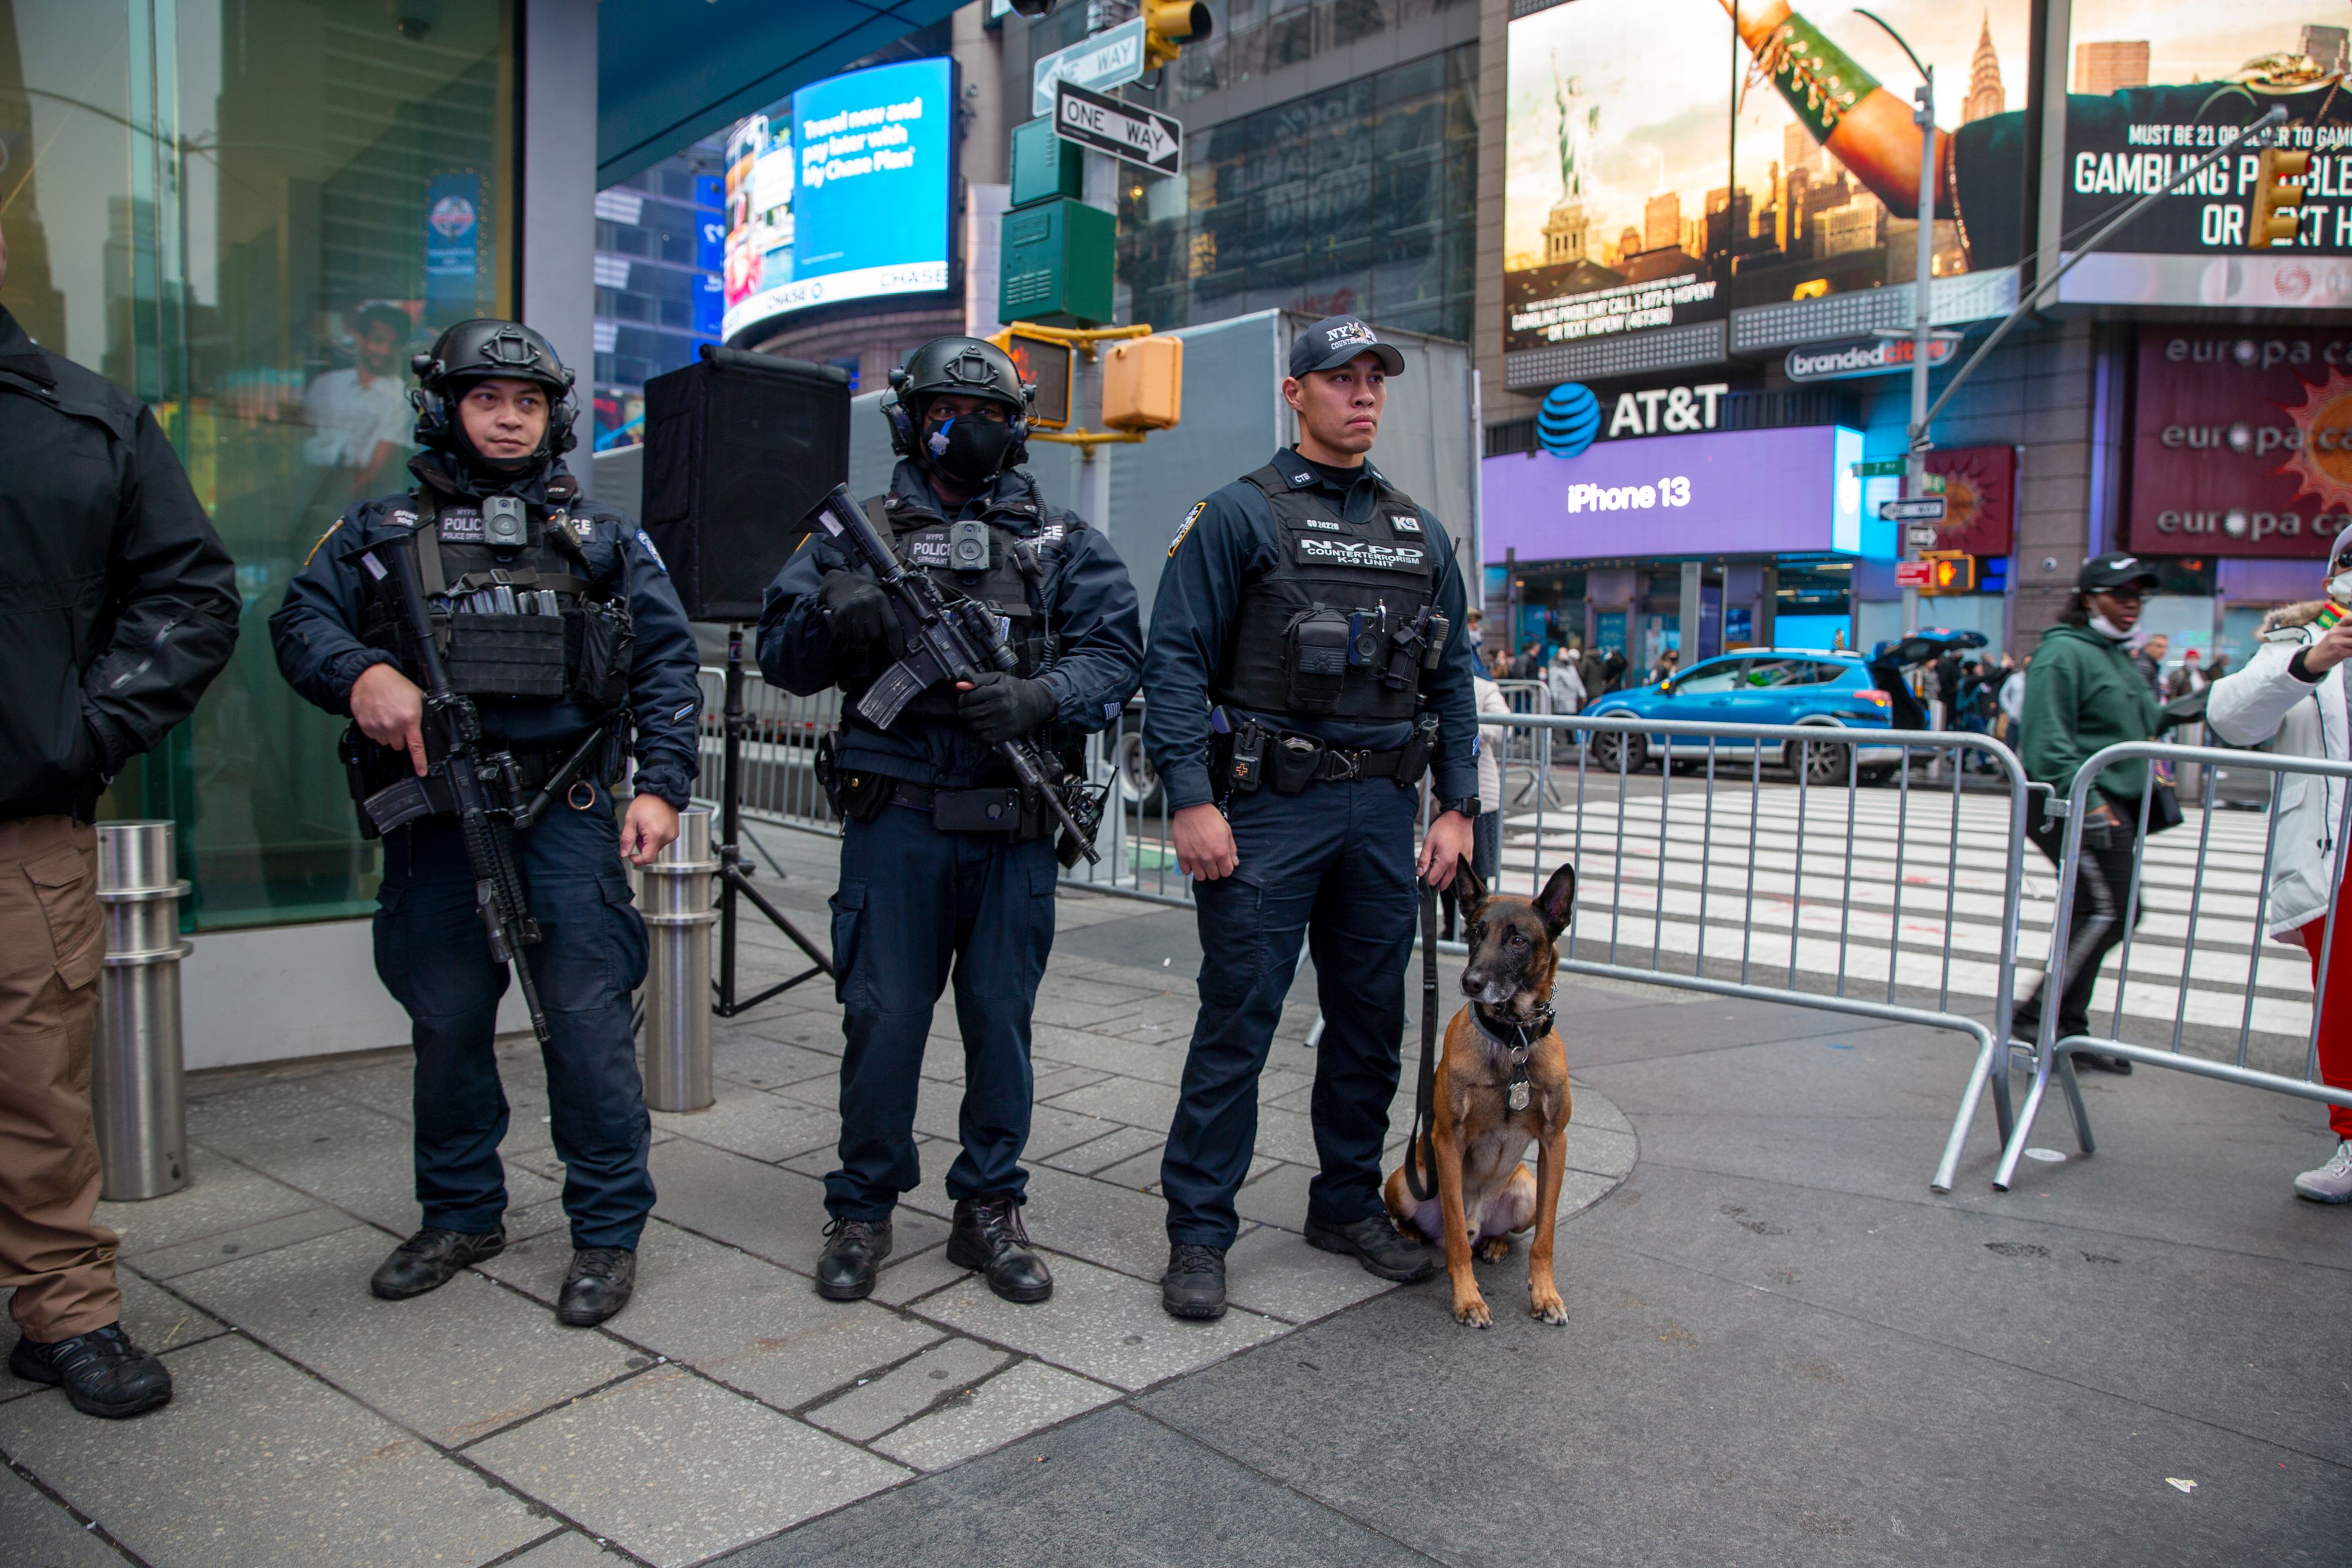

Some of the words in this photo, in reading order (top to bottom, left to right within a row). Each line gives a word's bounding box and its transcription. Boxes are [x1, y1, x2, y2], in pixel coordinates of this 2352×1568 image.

[1097, 42, 1132, 72] WAY
[803, 120, 847, 140] Travel
[848, 107, 886, 128] now
[886, 96, 922, 121] and
[1067, 101, 1104, 131] ONE
[1125, 121, 1164, 151] WAY
[803, 142, 828, 168] pay
[829, 135, 866, 156] later
[867, 123, 908, 148] with
[2129, 124, 2171, 145] MUST
[2174, 125, 2194, 145] BE
[2196, 125, 2216, 145] 21
[2218, 125, 2240, 146] OR
[2293, 126, 2314, 147] TO
[803, 165, 824, 188] My
[826, 156, 872, 180] Chase
[2075, 152, 2230, 196] GAMBLING
[2237, 154, 2352, 196] PBLE
[2201, 204, 2244, 246] OR
[881, 269, 948, 286] CHASE
[2166, 339, 2311, 370] europa
[1609, 383, 1729, 437] AT&T
[2161, 424, 2305, 458] europa
[1295, 473, 1311, 482] CTB
[1568, 483, 1656, 513] iPhone
[1658, 476, 1691, 507] 13
[1393, 516, 1420, 531] K9
[2156, 509, 2301, 542] europa
[917, 556, 948, 565] SERGEANT
[1301, 539, 1424, 557] NYPD
[1307, 548, 1419, 564] COUNTERTERRORISM
[1338, 556, 1361, 564] K-9
[1364, 558, 1394, 567] UNIT
